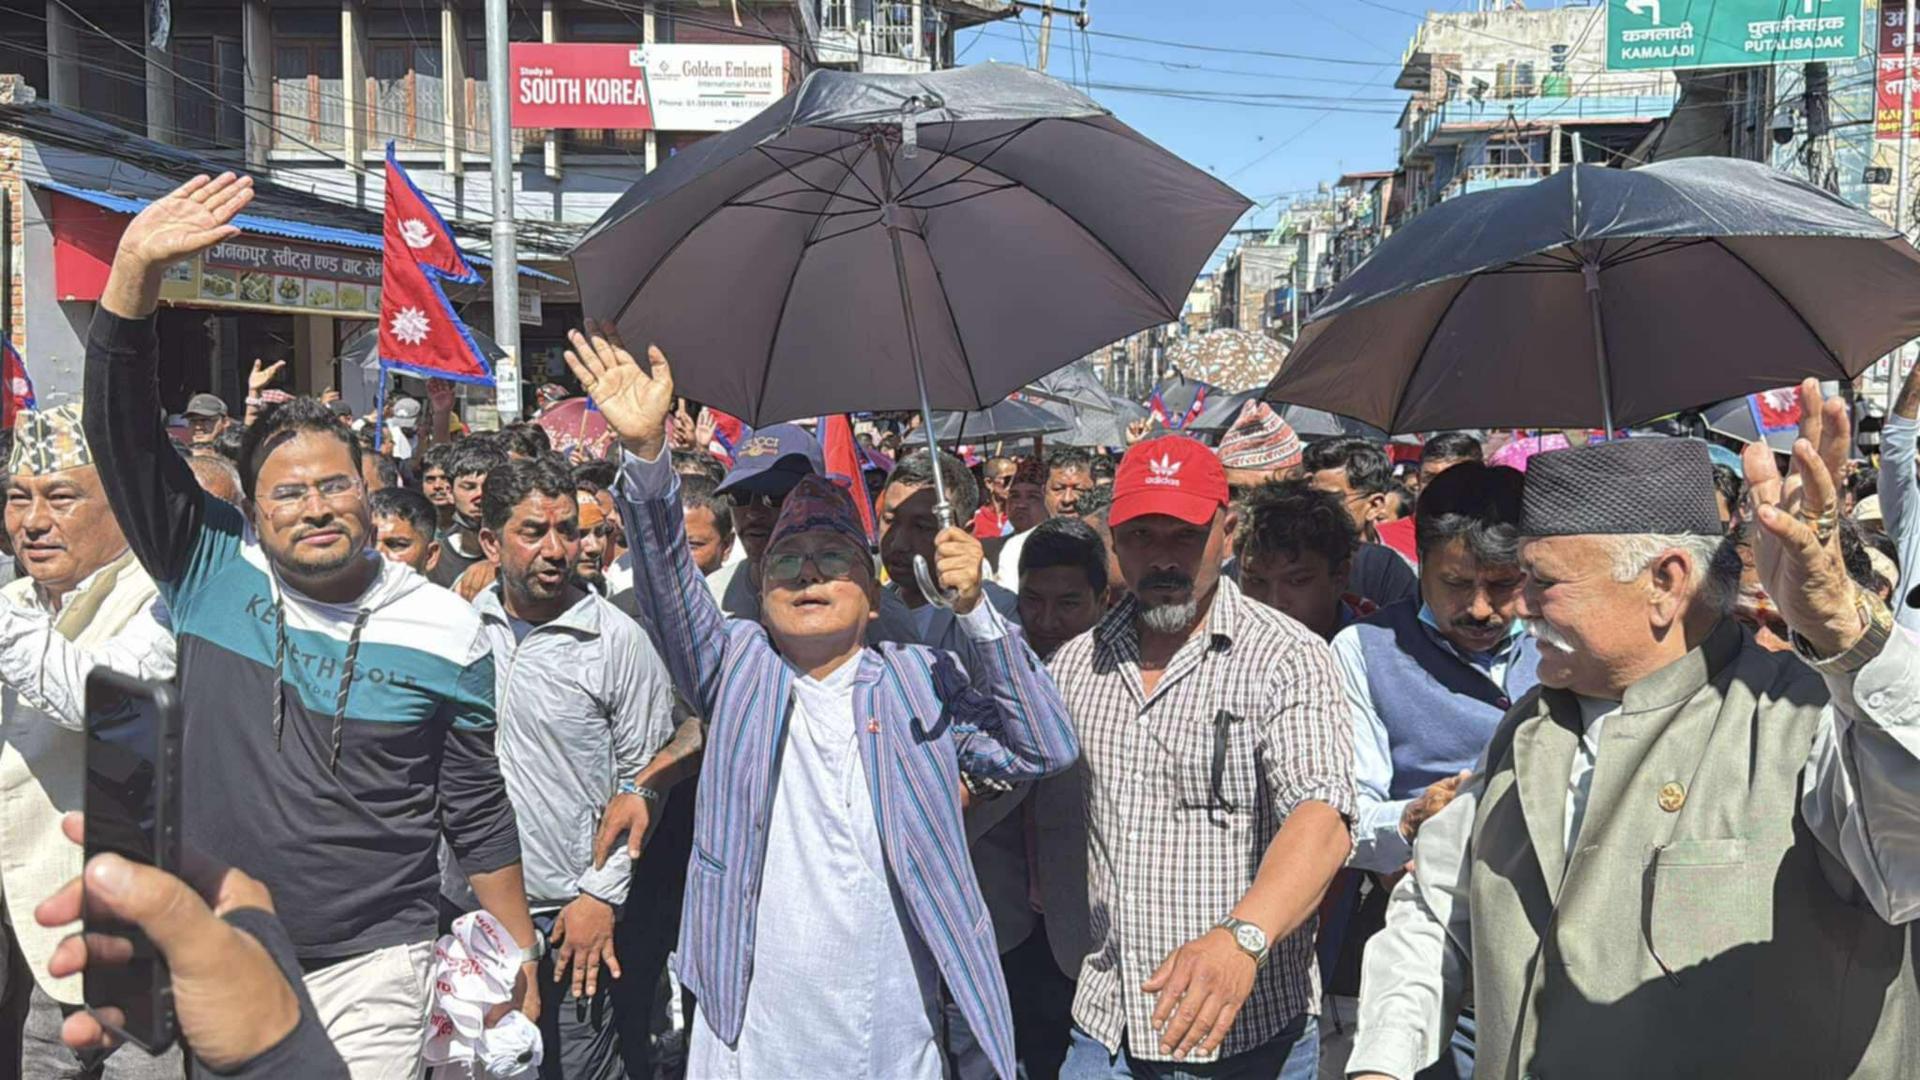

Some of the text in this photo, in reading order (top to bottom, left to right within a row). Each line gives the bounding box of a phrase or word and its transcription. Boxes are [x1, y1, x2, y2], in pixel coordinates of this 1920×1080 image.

[1622, 22, 1693, 42] कमलादी
[1622, 45, 1694, 59] KAMALADI
[1744, 36, 1844, 52] PUTALISADAK
[520, 67, 553, 77] Study in
[682, 60, 722, 77] Golden
[726, 61, 772, 78] Eminent
[520, 78, 646, 105] SOUTH KOREA
[211, 243, 270, 267] जनकपुर
[1145, 476, 1180, 487] adidas
[245, 593, 336, 680] KEETH
